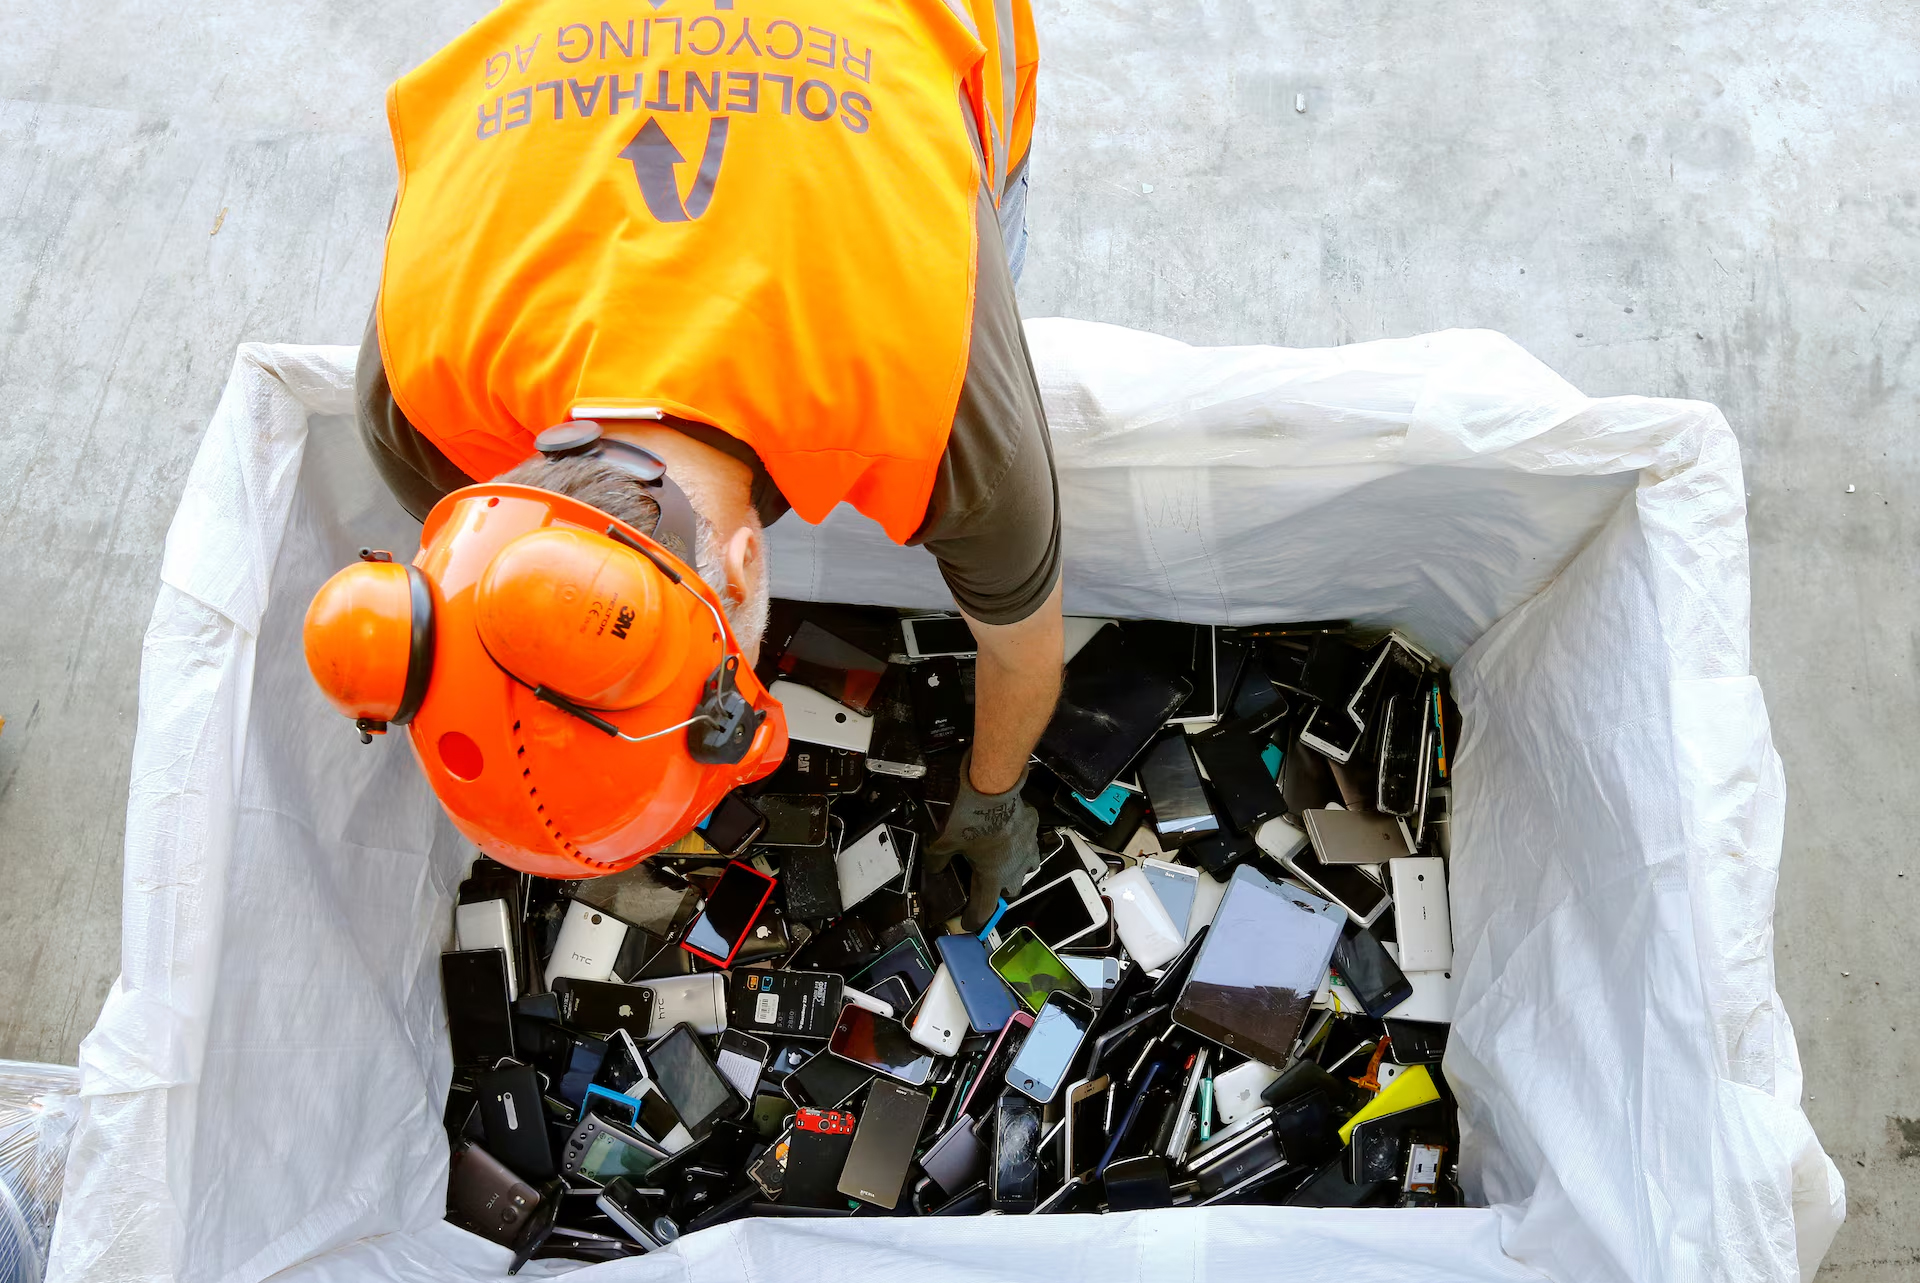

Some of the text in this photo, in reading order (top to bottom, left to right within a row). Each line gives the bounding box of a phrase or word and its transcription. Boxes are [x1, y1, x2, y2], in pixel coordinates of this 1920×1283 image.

[485, 15, 872, 90] RECYCLING AG
[476, 70, 873, 141] SOLENTHALER
[610, 605, 636, 640] 3M
[797, 753, 811, 773] CAT
